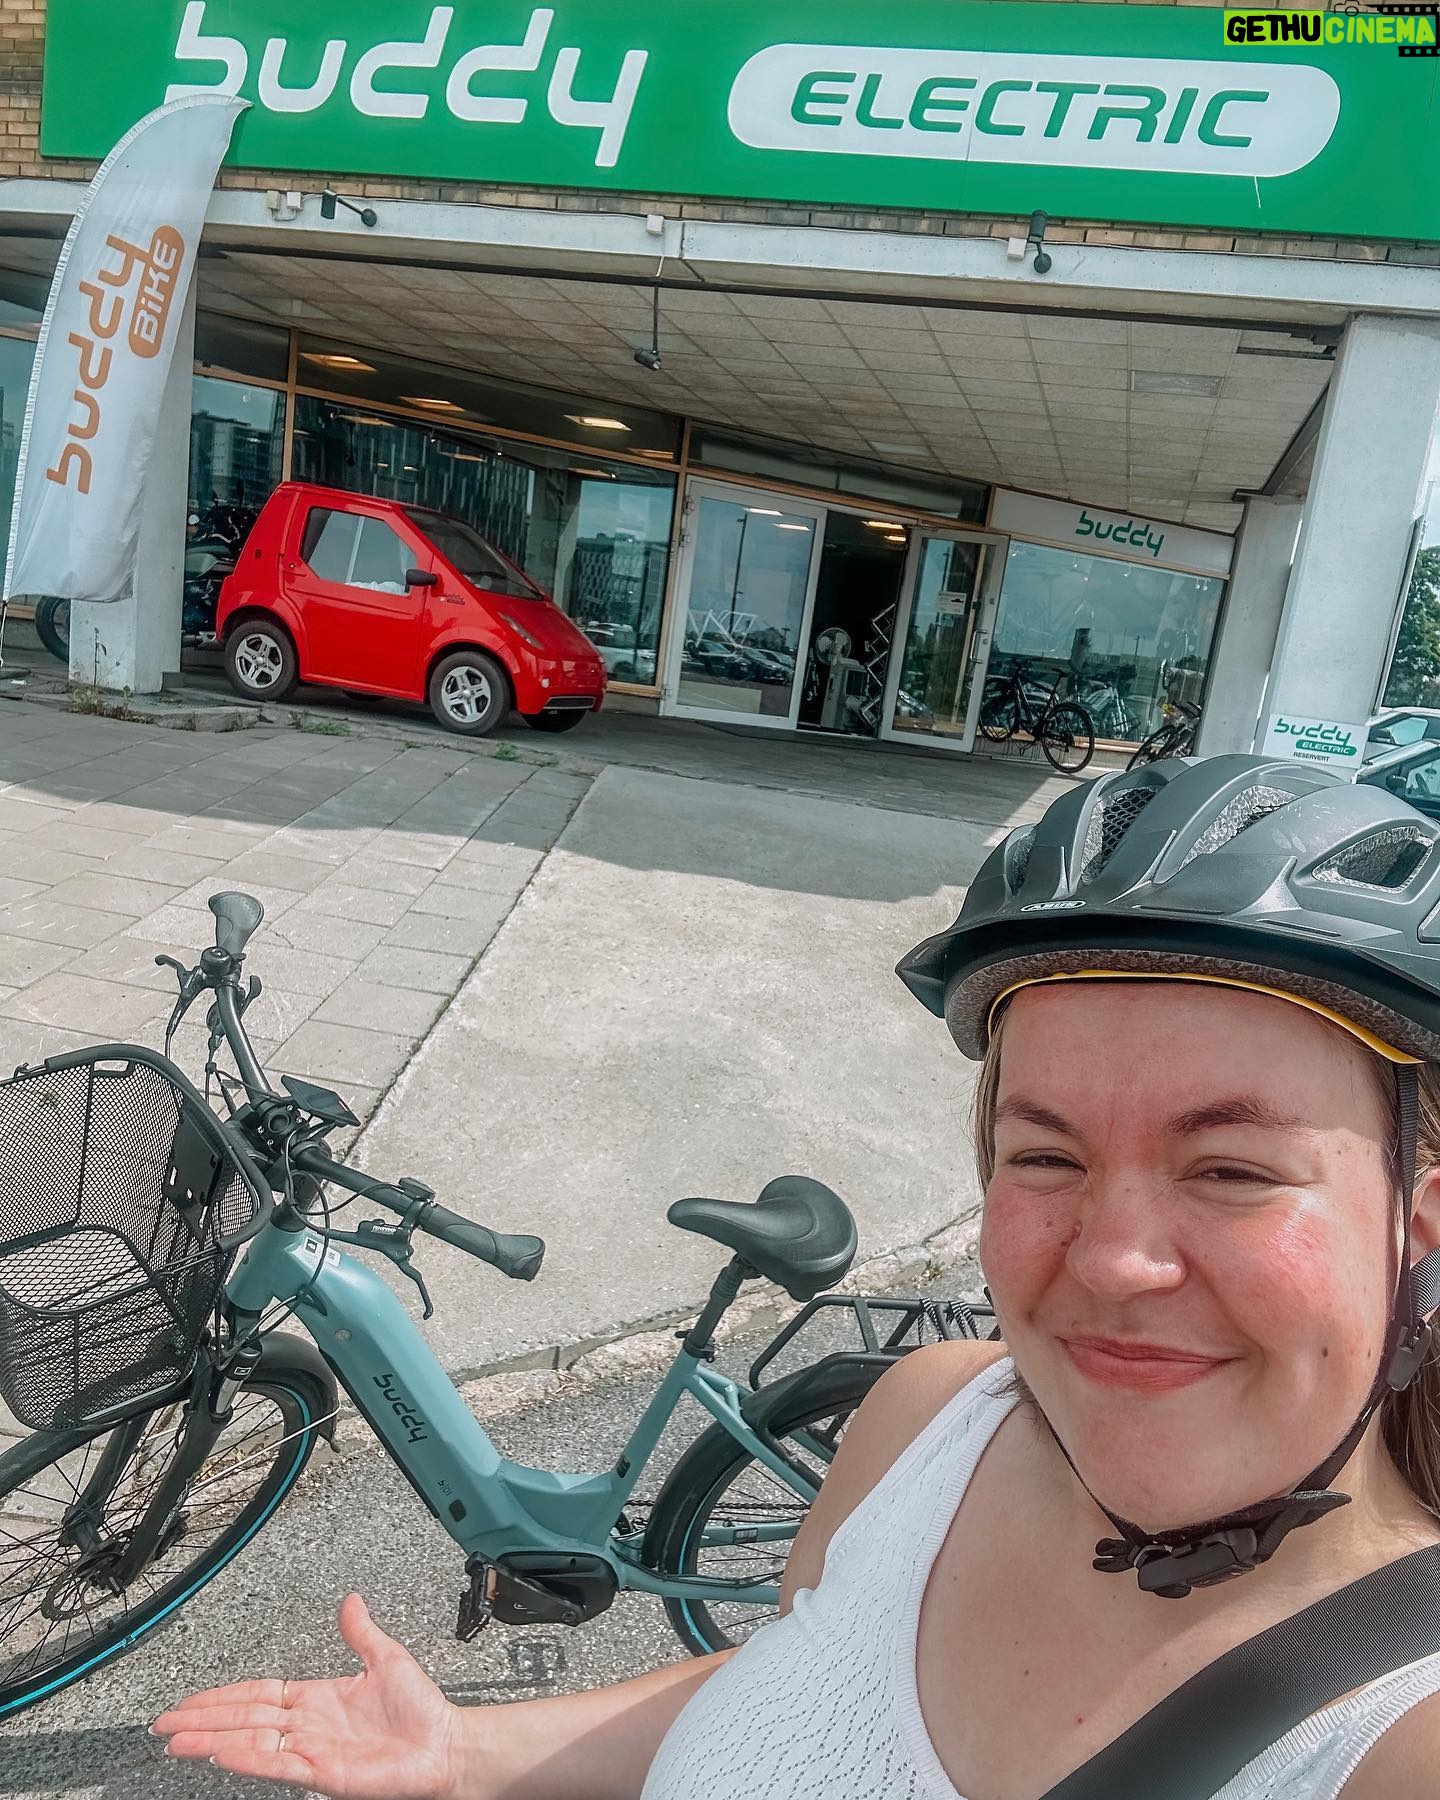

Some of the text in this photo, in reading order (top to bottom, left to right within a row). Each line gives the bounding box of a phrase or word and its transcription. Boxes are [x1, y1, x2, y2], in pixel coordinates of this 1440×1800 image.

[164, 1, 1270, 167] buddy ELECTRIC
[46, 234, 150, 494] buddy
[1075, 510, 1165, 557] buddy
[1274, 717, 1352, 747] buddy
[1302, 741, 1351, 754] ELECTRIC
[1293, 751, 1331, 762] RESERVERT
[372, 1373, 428, 1443] buddy
